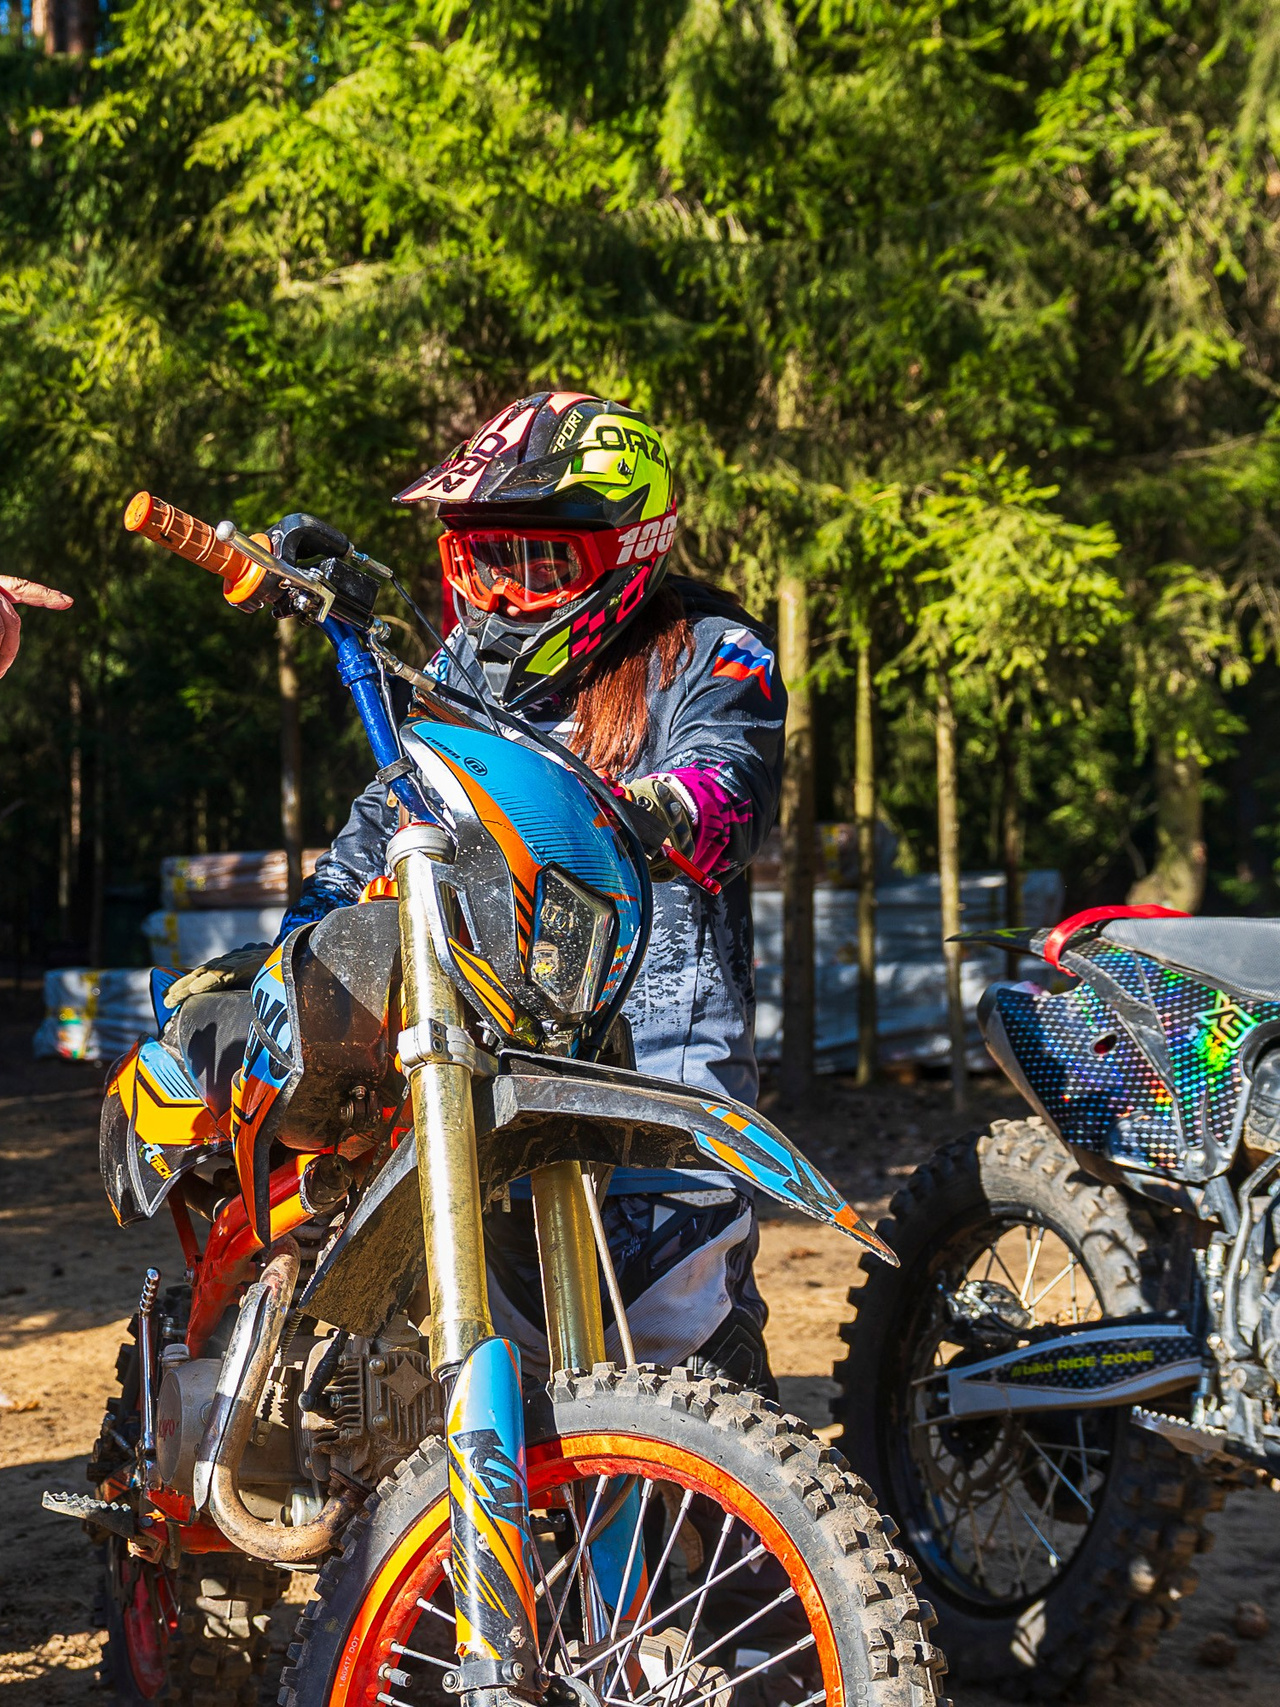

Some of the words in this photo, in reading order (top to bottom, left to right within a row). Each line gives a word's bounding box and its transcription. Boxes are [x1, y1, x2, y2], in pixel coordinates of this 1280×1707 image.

[616, 515, 677, 565] 100
[1057, 1355, 1098, 1372] RIDE
[1101, 1348, 1155, 1366] ZONE
